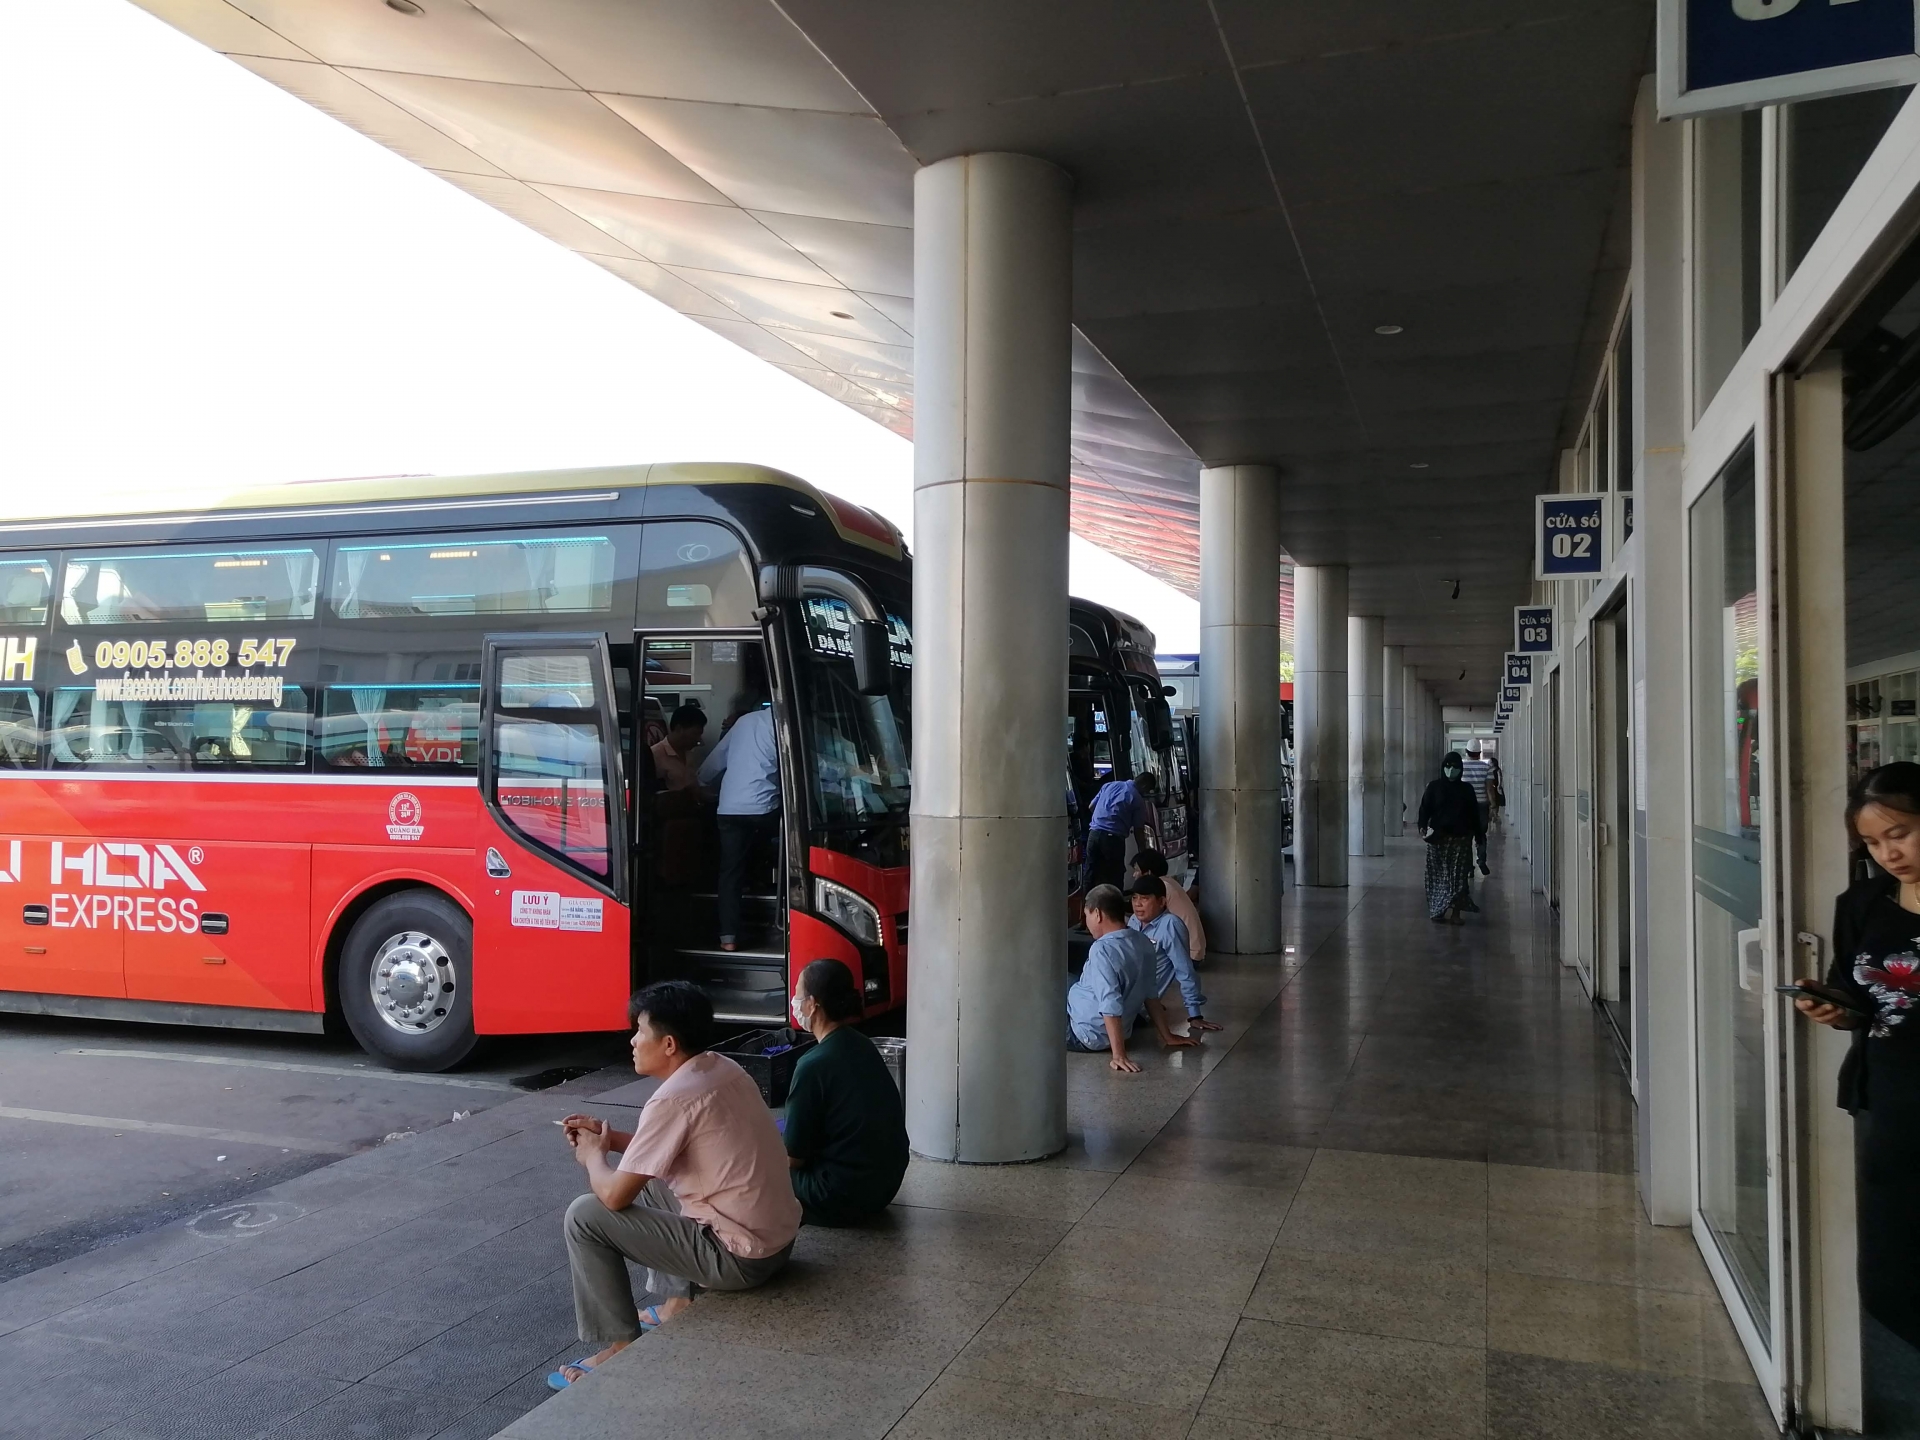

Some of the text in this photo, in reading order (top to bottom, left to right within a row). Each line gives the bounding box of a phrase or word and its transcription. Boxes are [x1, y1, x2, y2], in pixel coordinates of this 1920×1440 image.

[1546, 512, 1577, 528] CỬA
[1552, 533, 1592, 558] 02
[1524, 627, 1548, 642] 03
[95, 638, 296, 668] 0905.888 547
[1511, 666, 1528, 678] 04
[1506, 688, 1520, 697] 05
[51, 842, 207, 891] HOA
[522, 893, 549, 906] LƯU Ý
[51, 893, 199, 933] EXPRESS
